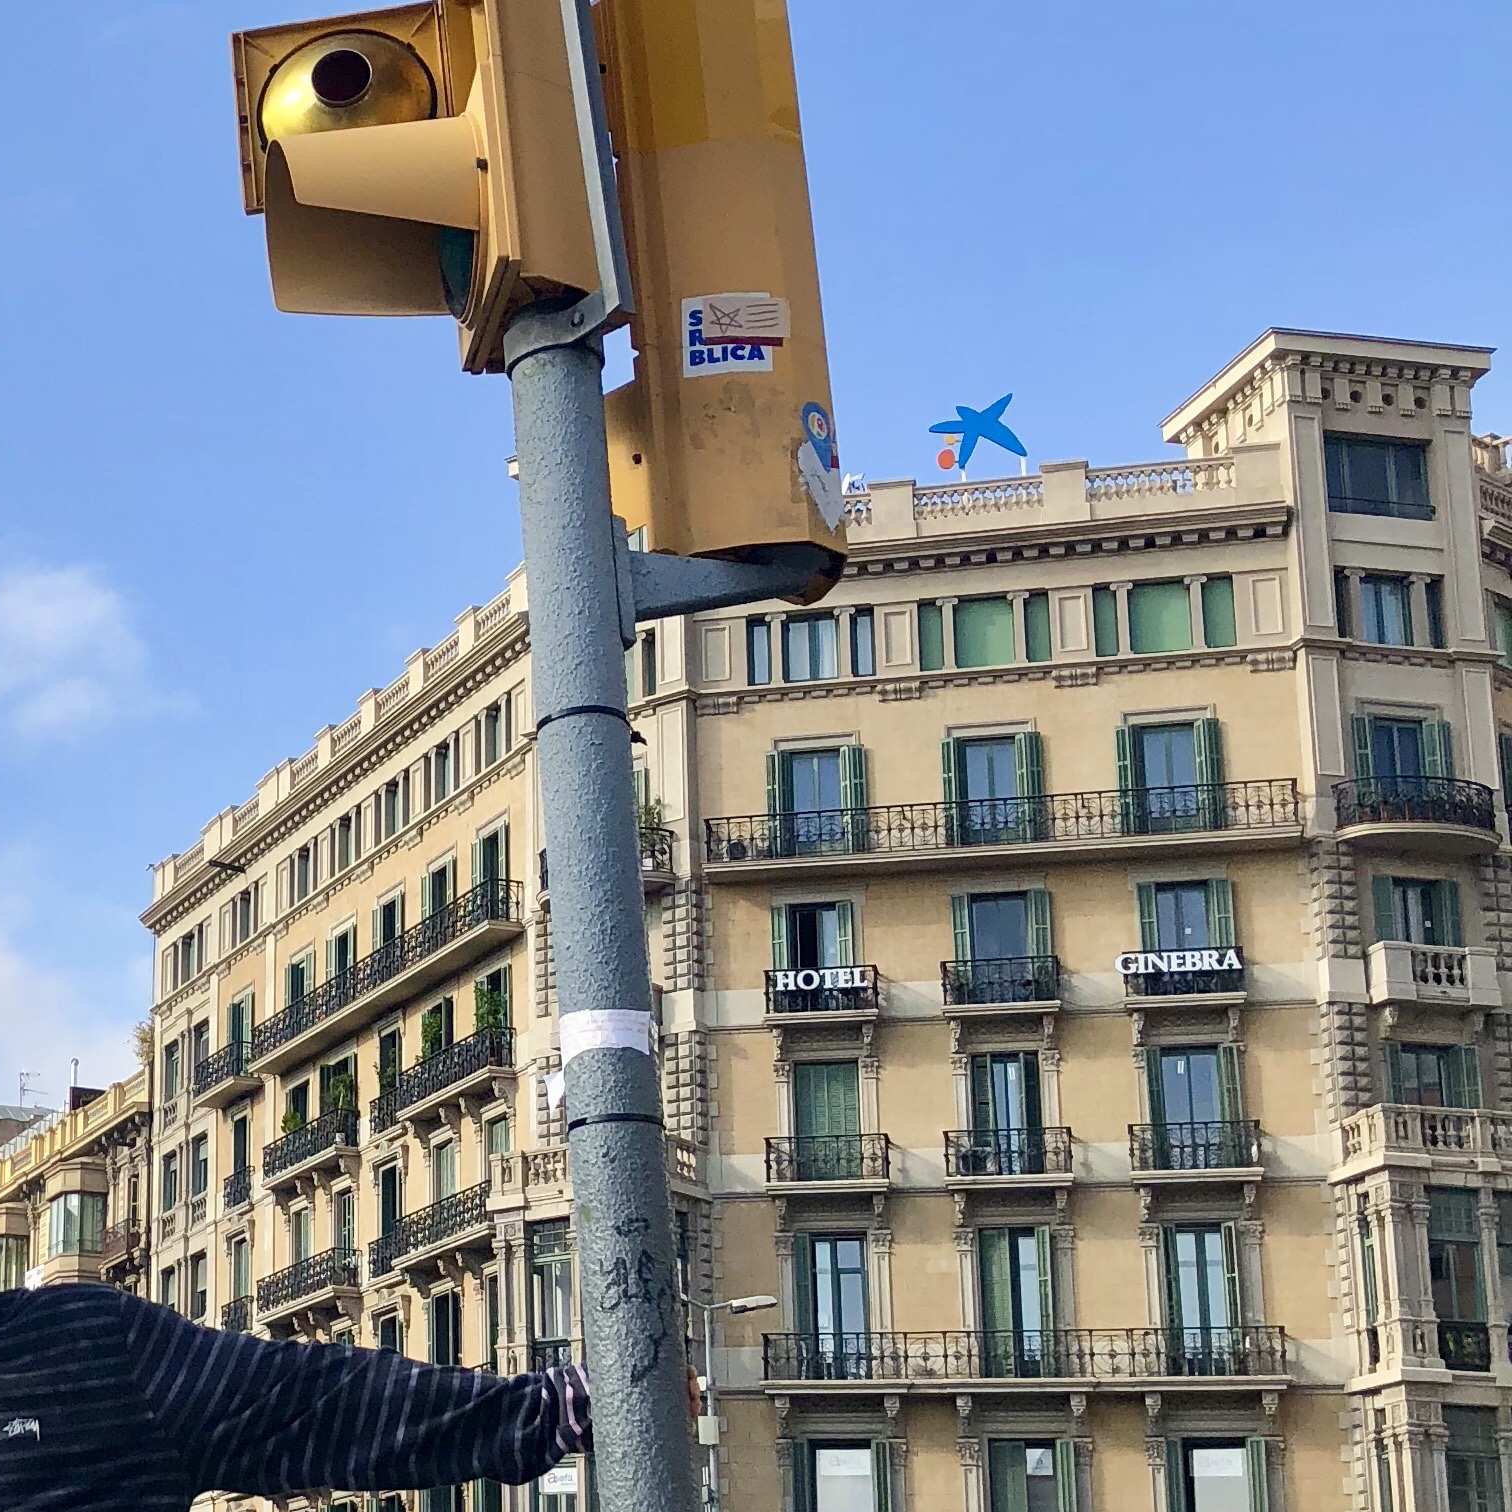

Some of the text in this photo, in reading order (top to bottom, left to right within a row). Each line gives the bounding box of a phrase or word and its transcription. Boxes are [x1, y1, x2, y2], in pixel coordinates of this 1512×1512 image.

[690, 345, 765, 366] BLICA
[1114, 948, 1242, 975] GINEBRA
[775, 967, 868, 991] HOTEL
